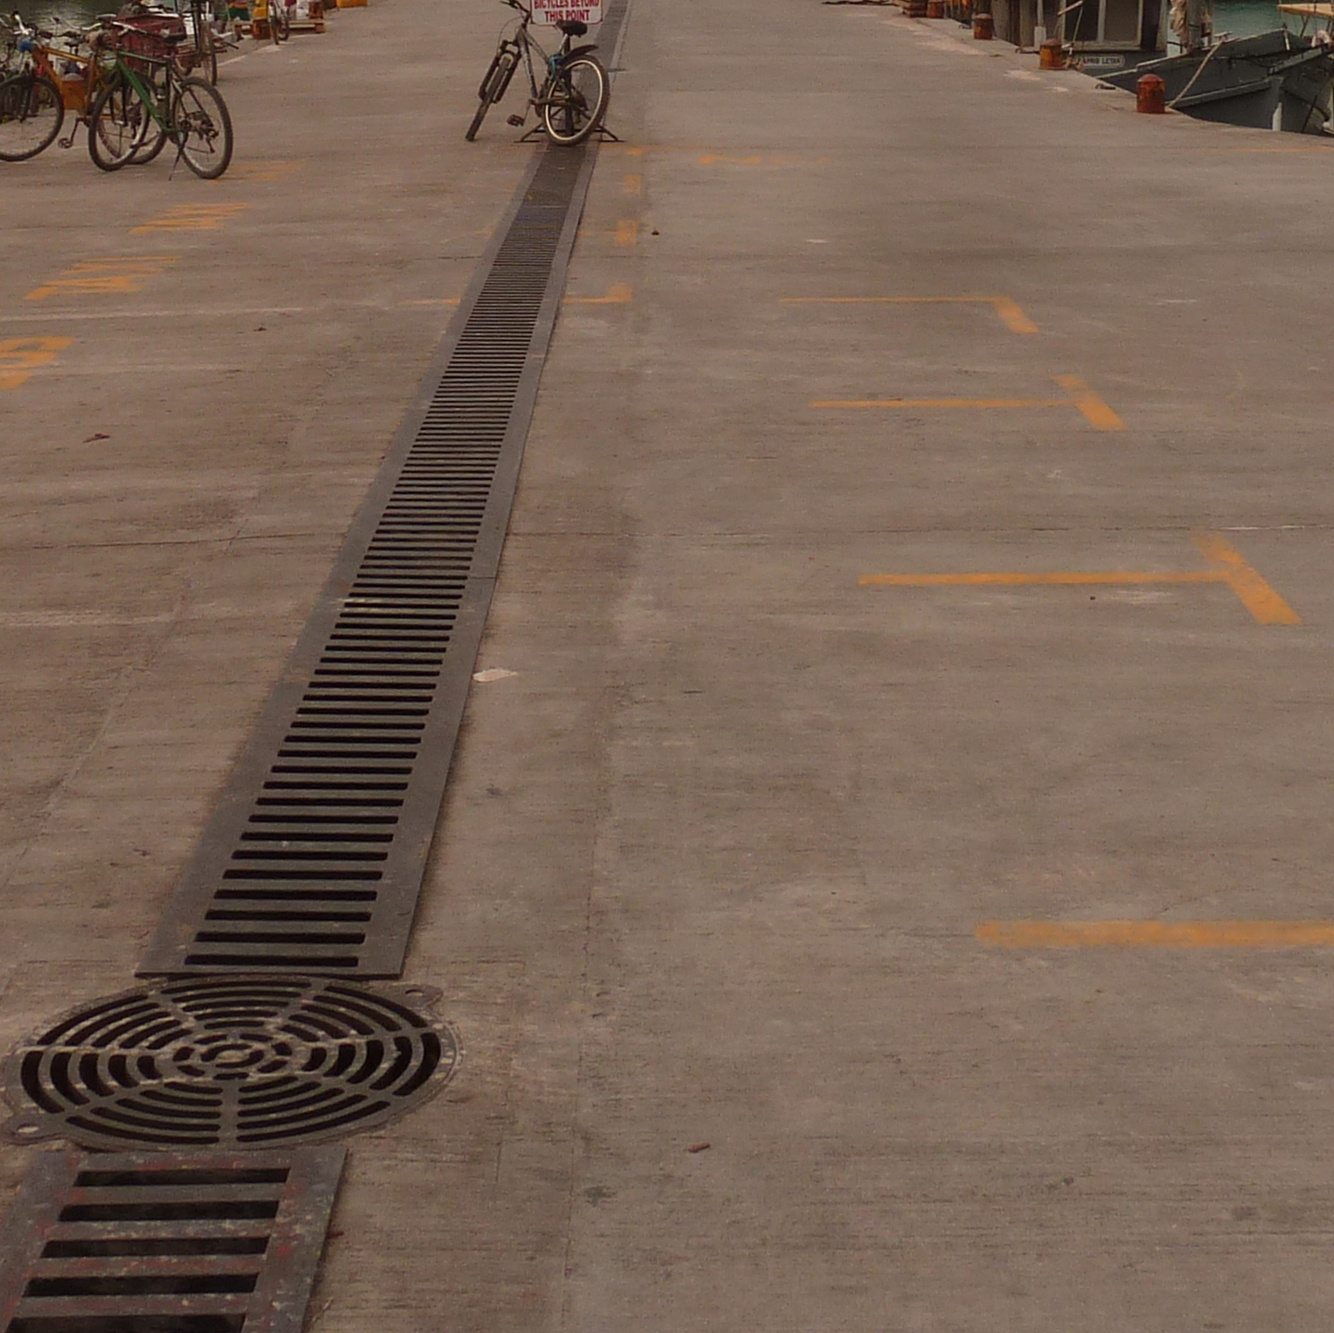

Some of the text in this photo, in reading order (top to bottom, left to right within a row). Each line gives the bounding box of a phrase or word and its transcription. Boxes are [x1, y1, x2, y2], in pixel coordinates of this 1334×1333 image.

[545, 9, 590, 22] THIS POINT
[23, 255, 183, 300] TAXI
